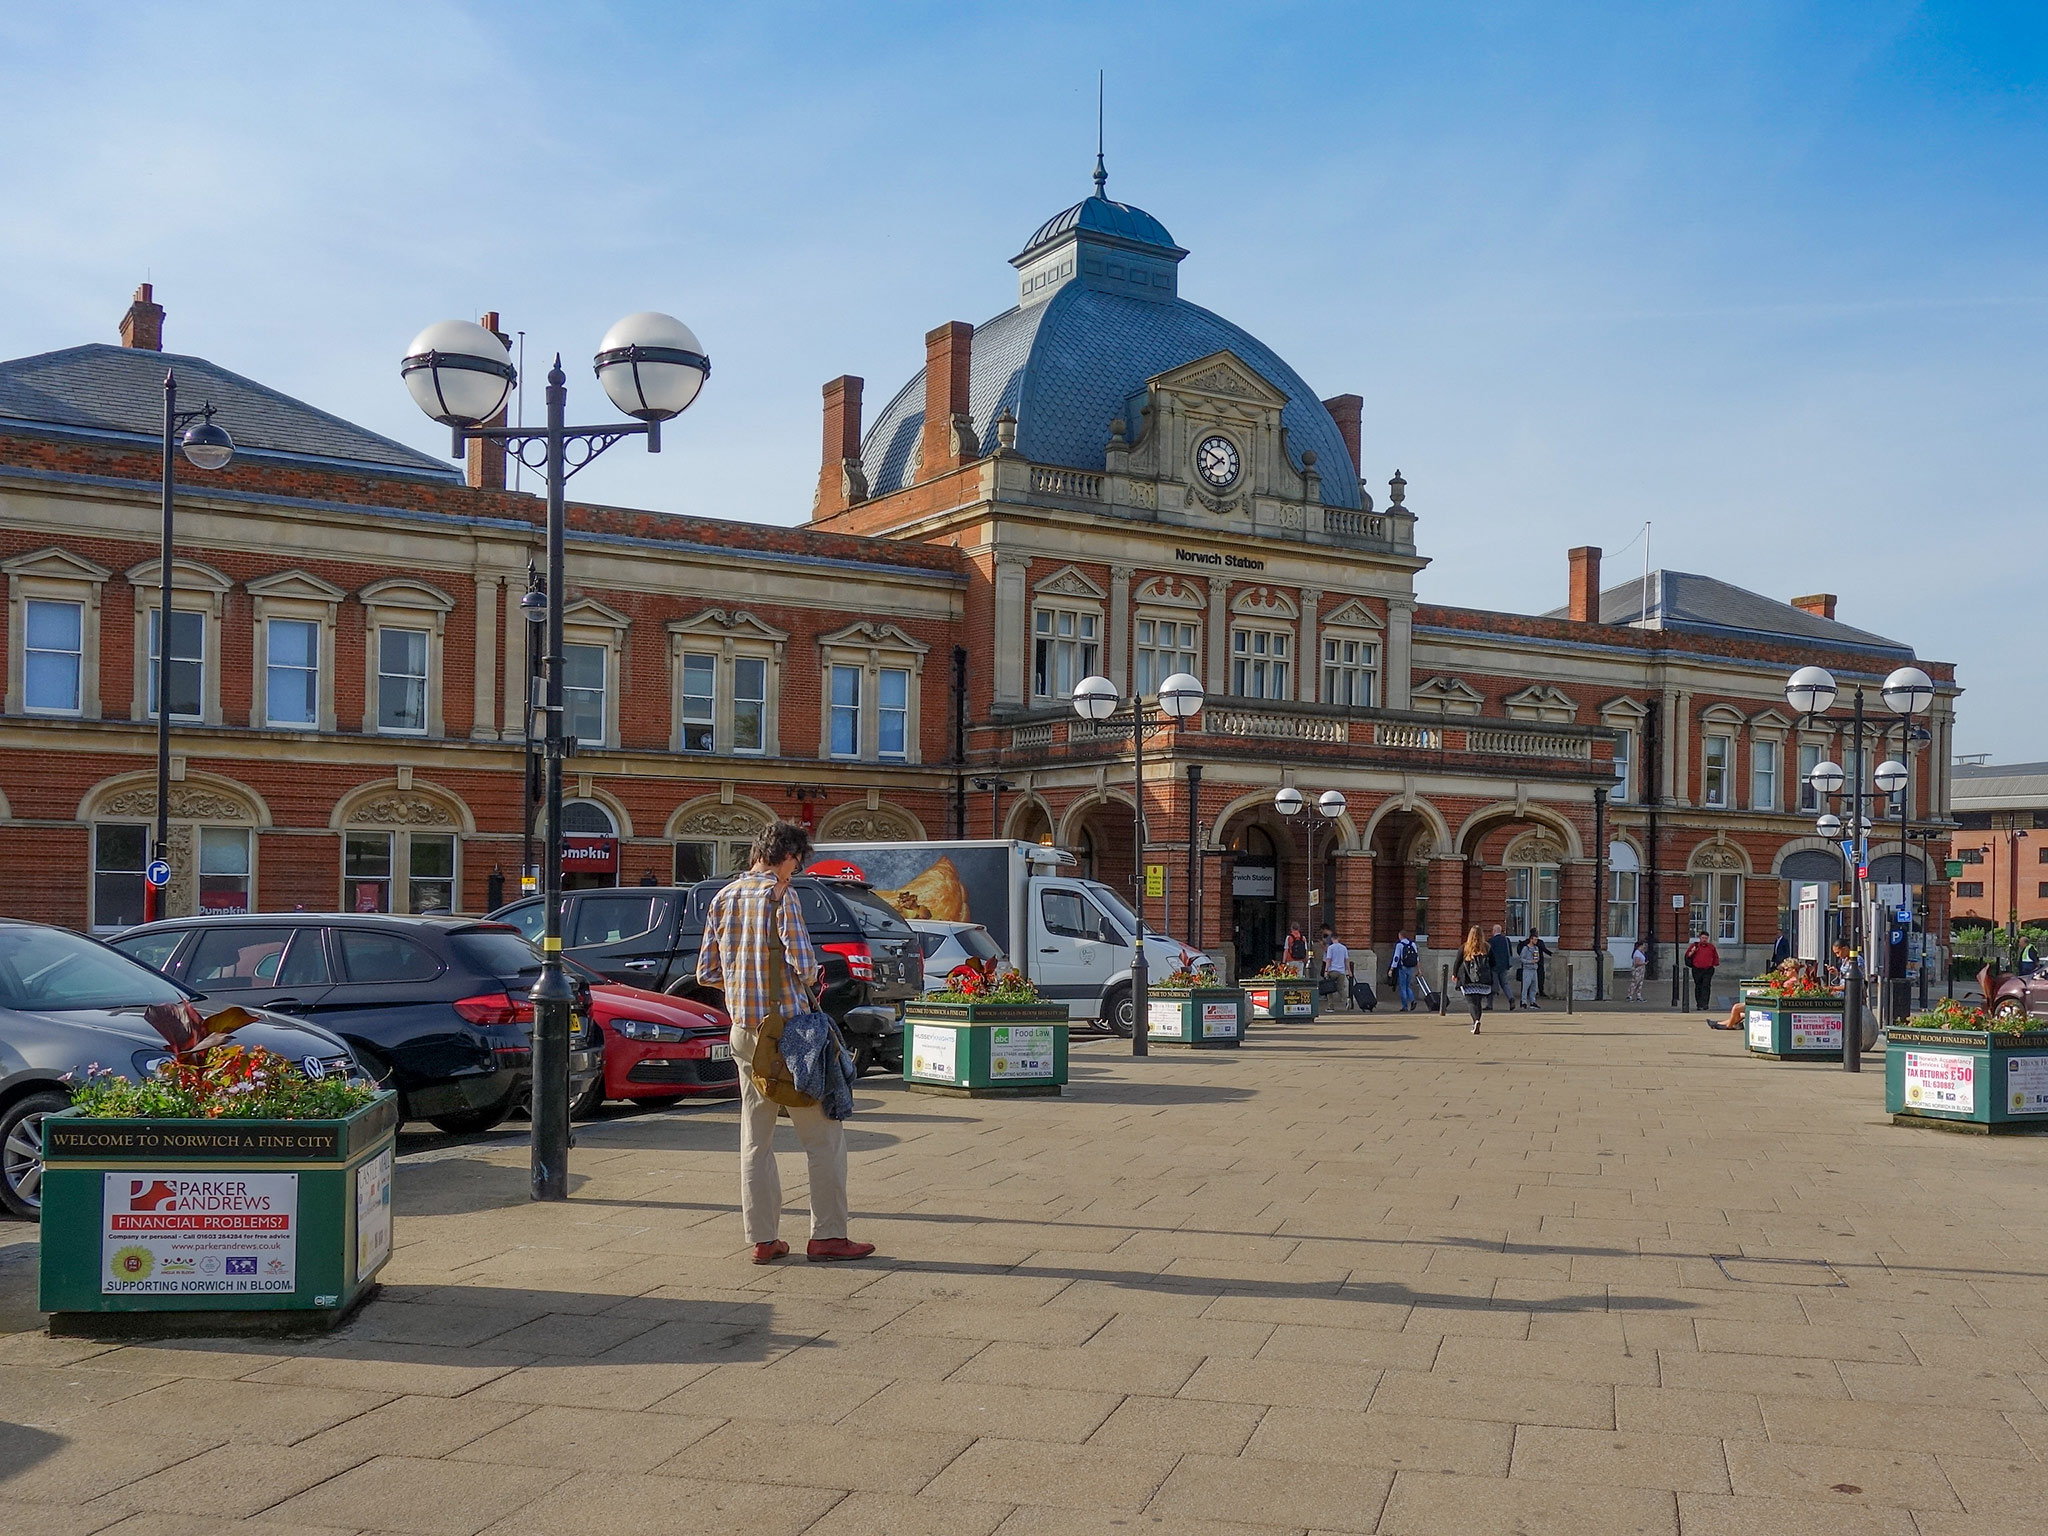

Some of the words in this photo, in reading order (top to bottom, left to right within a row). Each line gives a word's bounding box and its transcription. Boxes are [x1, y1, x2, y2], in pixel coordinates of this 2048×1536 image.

[1175, 548, 1222, 565] Norwich
[1224, 554, 1265, 571] Station
[561, 846, 610, 859] umpkin
[1015, 1028, 1034, 1037] Food
[1035, 1028, 1050, 1037] Law
[1888, 1032, 1912, 1040] BRITAIN
[1920, 1034, 1942, 1043] BLOOM
[995, 1034, 1009, 1043] abc
[1995, 1038, 2032, 1046] WELCOME
[2032, 1037, 2043, 1046] TO
[1939, 1056, 1972, 1065] Accountancy
[1907, 1068, 1919, 1078] TAX
[1919, 1069, 1949, 1080] RETURNS
[1950, 1067, 1972, 1082] £50
[1907, 1100, 1932, 1108] SUPPORTING
[1932, 1102, 1952, 1110] NORWICH
[53, 1134, 134, 1147] WELCOME
[136, 1134, 159, 1147] TO
[163, 1134, 240, 1147] NORWICH
[243, 1135, 254, 1147] A
[258, 1135, 295, 1148] FINE
[297, 1136, 334, 1148] CITY
[179, 1181, 248, 1196] PARKER
[178, 1196, 271, 1211] ANDREWS
[118, 1216, 200, 1229] FINANCIAL
[203, 1216, 283, 1229] PROBLEMS?
[108, 1233, 140, 1241] Company
[149, 1233, 178, 1241] personal
[171, 1242, 282, 1252] www.parkerandrews.co.uk
[107, 1281, 179, 1292] SUPPORTING
[181, 1281, 234, 1291] NORWICH
[236, 1281, 248, 1291] IN
[250, 1281, 290, 1291] BLOOM
